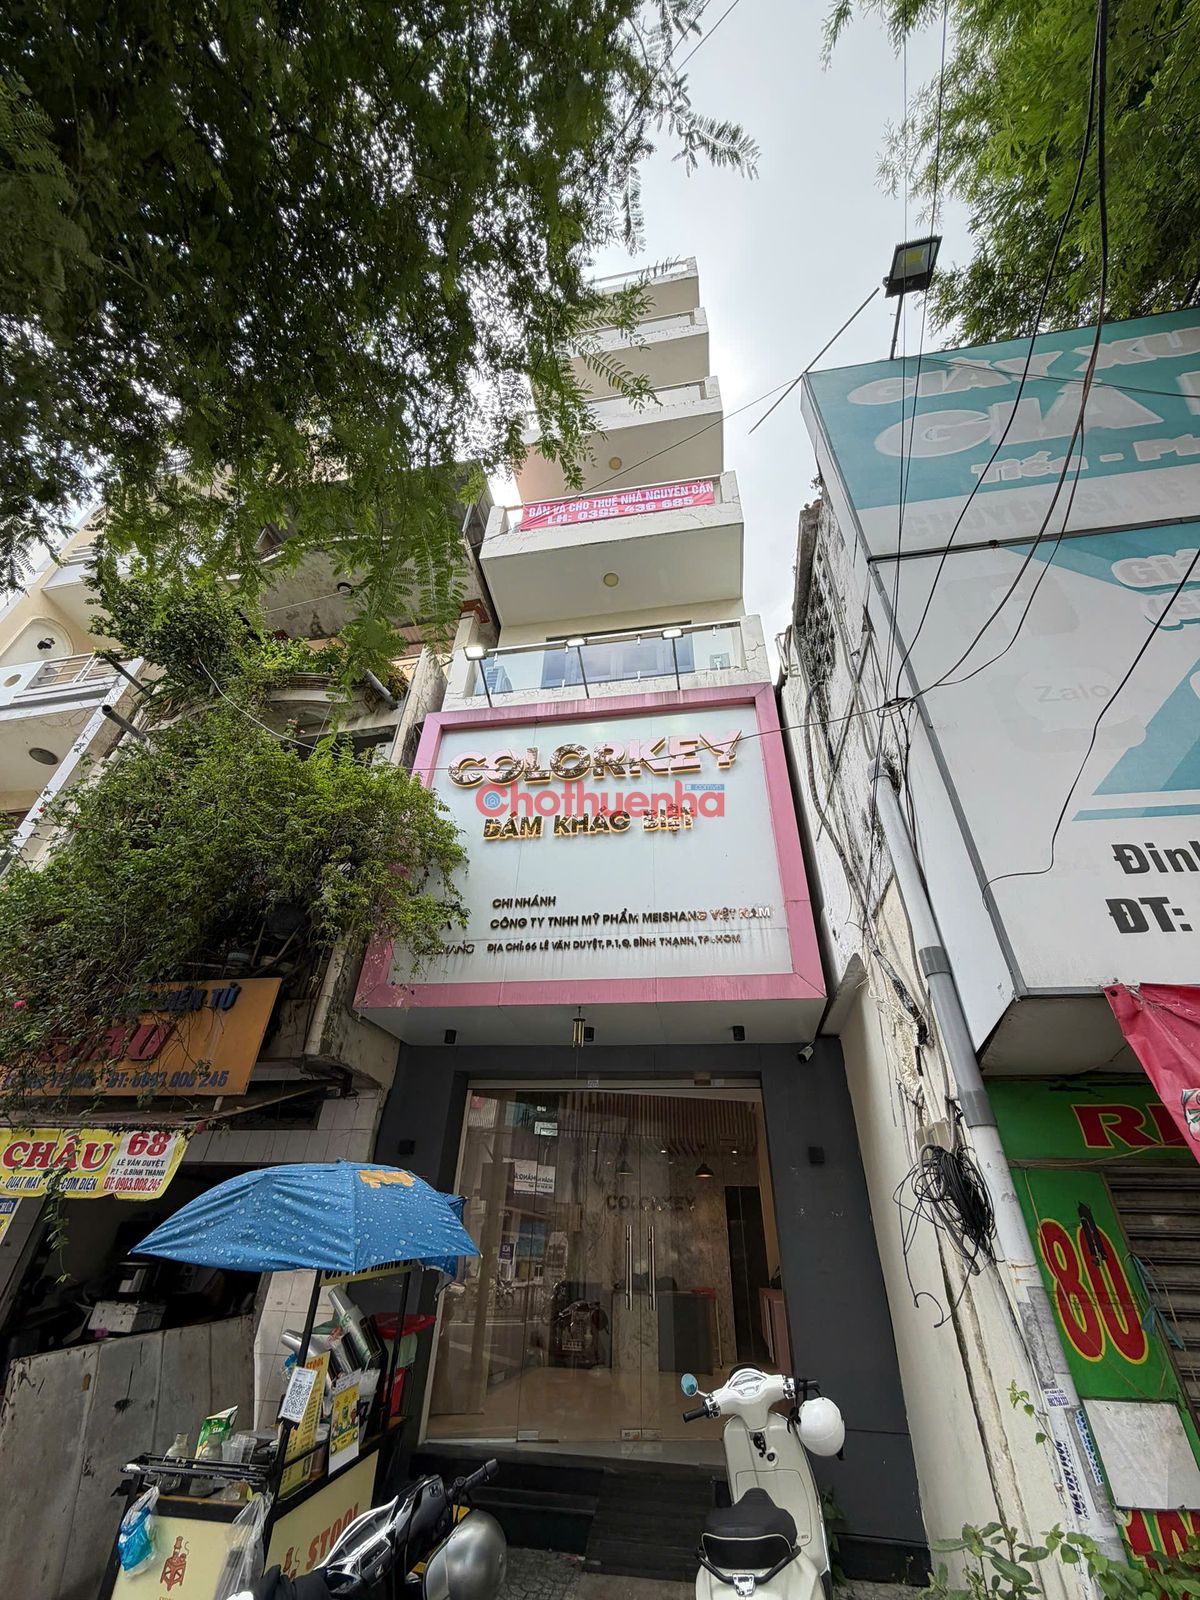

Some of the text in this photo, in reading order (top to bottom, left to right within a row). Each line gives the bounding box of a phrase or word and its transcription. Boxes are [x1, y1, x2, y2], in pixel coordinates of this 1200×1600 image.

[569, 501, 589, 512] CHO
[447, 729, 743, 788] COLORKEY
[554, 804, 632, 836] KHÁC
[514, 894, 557, 908] NHÁNH
[490, 916, 528, 930] CÔNG
[530, 916, 545, 928] TY
[548, 915, 579, 927] TNHH
[581, 912, 600, 926] MỸ
[642, 909, 707, 924] MEISHANG
[1105, 896, 1193, 933] ĐT:
[552, 939, 571, 951] VĂN
[126, 1131, 172, 1157] 68
[1037, 1217, 1149, 1365] 80
